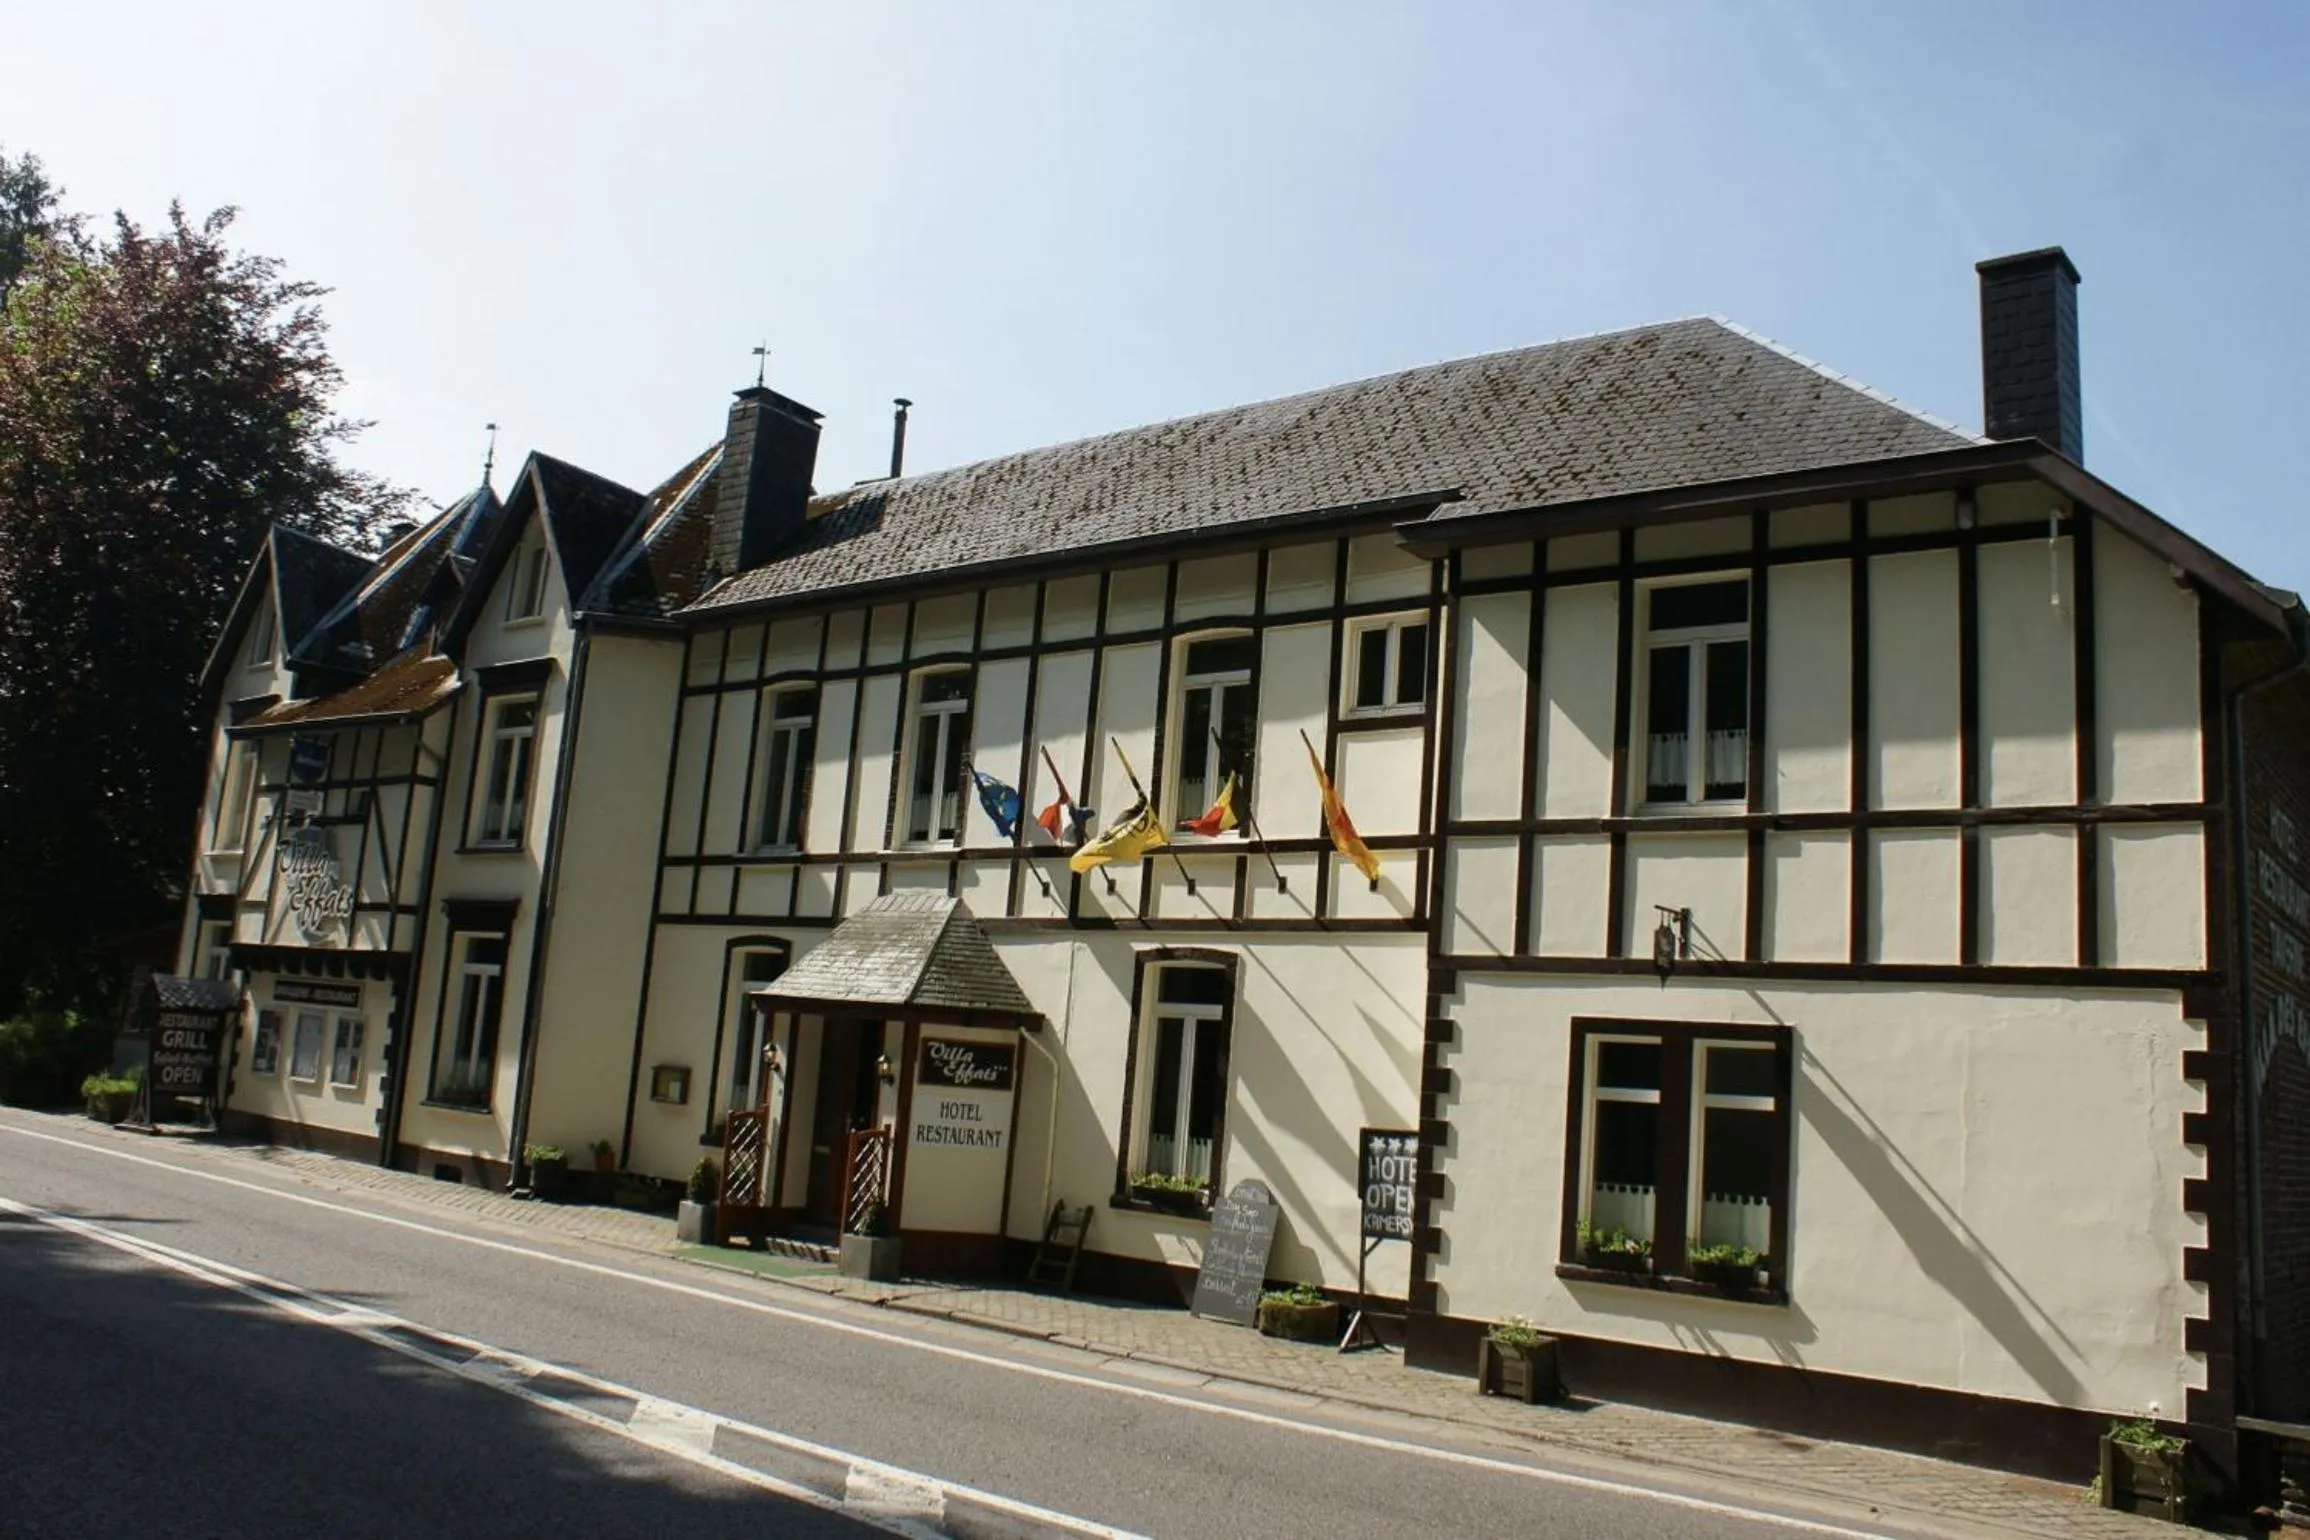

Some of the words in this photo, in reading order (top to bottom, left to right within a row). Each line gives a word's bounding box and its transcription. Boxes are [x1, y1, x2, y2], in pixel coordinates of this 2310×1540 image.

[277, 840, 330, 876] Villa
[162, 1030, 208, 1049] GRILL
[928, 1041, 974, 1062] Villa
[162, 1066, 205, 1084] OPEN
[943, 1059, 998, 1084] Effats
[939, 1101, 982, 1122] HOTEL
[915, 1124, 1003, 1147] RESTAURANT
[1368, 1155, 1418, 1183] HOTE
